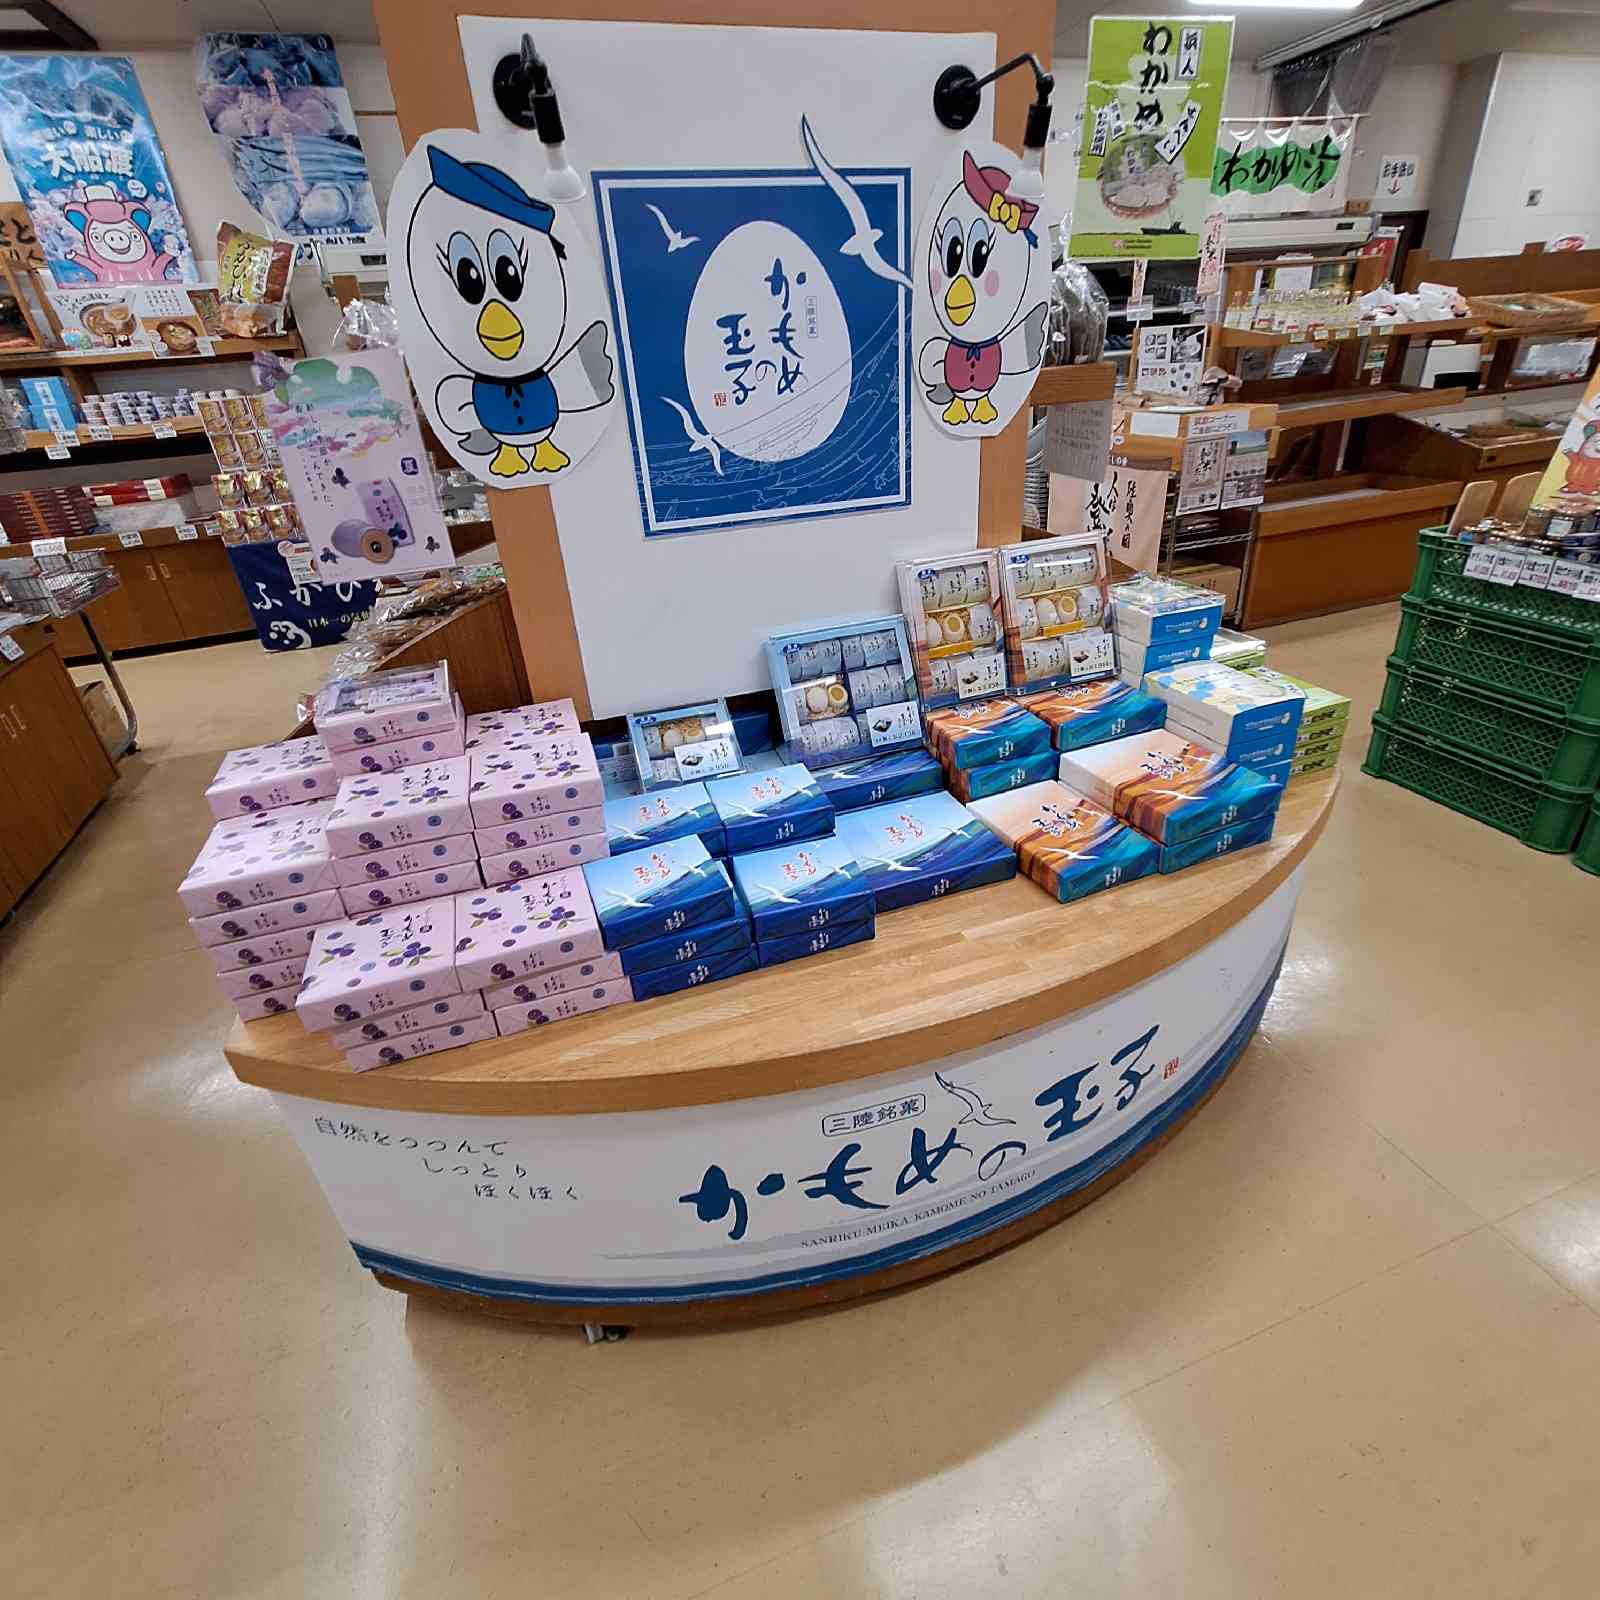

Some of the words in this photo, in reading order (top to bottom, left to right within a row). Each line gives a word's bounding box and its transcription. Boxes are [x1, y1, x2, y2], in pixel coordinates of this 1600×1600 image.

[1134, 21, 1173, 130] わかめ
[41, 142, 133, 178] 大船渡
[679, 1024, 1160, 1240] かもめの玉子
[829, 1098, 919, 1133] 三陸銘菓
[423, 1158, 528, 1178] しっとり
[800, 1228, 863, 1249] SANRIKU
[865, 1218, 911, 1236] MEIKA
[913, 1197, 967, 1222] KAMOME
[969, 1190, 987, 1202] NO
[990, 1168, 1037, 1194] TAMAGO
